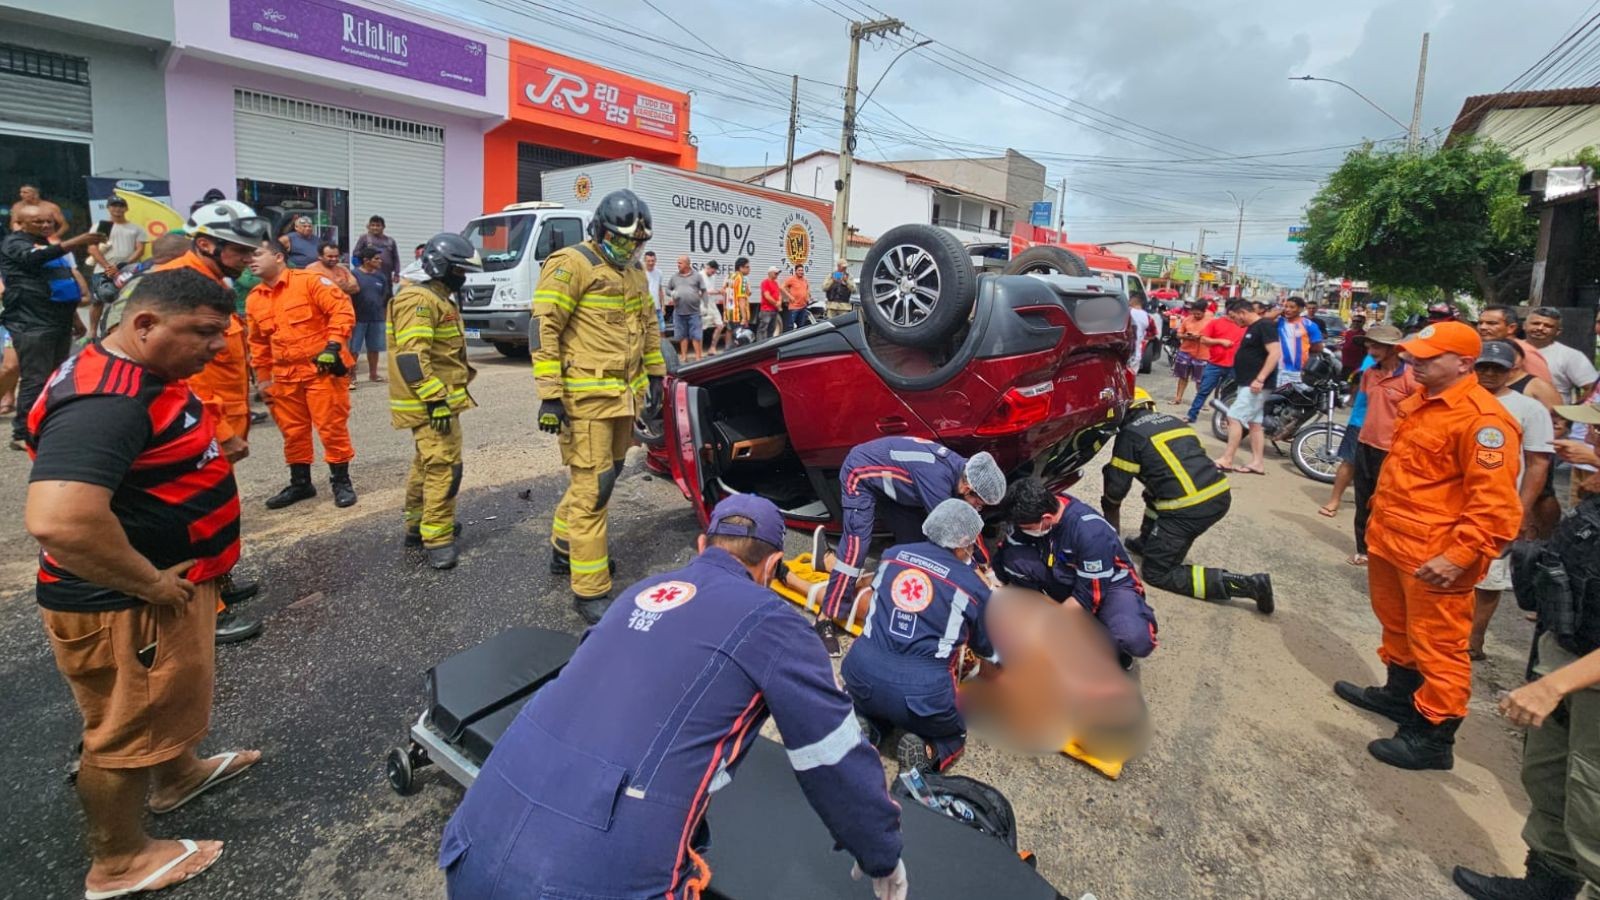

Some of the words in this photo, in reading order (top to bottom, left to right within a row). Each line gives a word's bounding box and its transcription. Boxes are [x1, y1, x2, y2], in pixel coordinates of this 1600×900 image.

[593, 83, 619, 103] 20
[640, 97, 658, 108] TUDO
[659, 102, 671, 111] EM
[605, 104, 630, 125] 25
[635, 108, 675, 122] VARIEDADES
[672, 195, 734, 216] QUEREMOS
[736, 206, 762, 220] VOCÊ
[685, 220, 755, 256] 100%
[779, 213, 794, 247] ELIZEU
[796, 212, 815, 249] MARTINS
[631, 608, 663, 621] SAMU
[897, 611, 913, 621] SAMU
[628, 616, 654, 632] 192
[898, 622, 908, 631] 192
